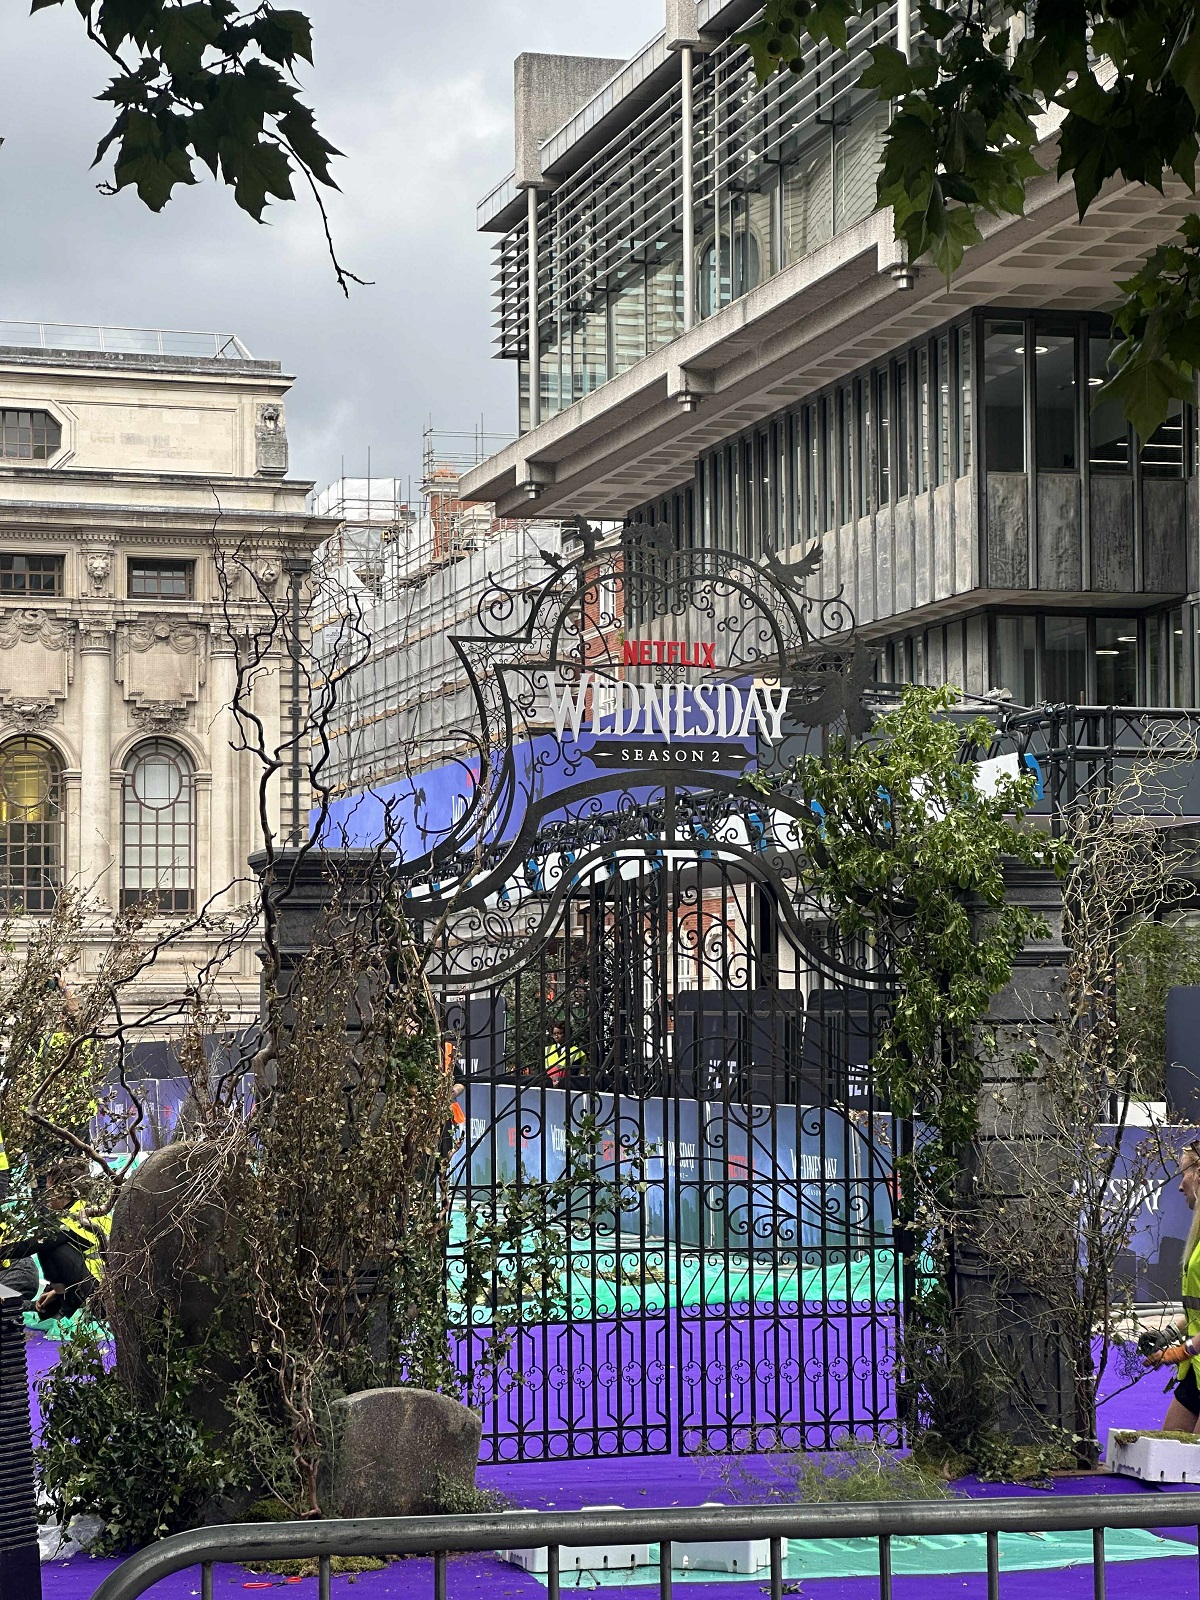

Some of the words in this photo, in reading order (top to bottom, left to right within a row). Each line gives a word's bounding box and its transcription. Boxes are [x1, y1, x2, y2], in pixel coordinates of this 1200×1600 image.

[623, 640, 716, 669] NETFLIX
[543, 671, 792, 747] WEDNESDAY
[621, 749, 704, 762] SEASON
[711, 750, 720, 763] 2
